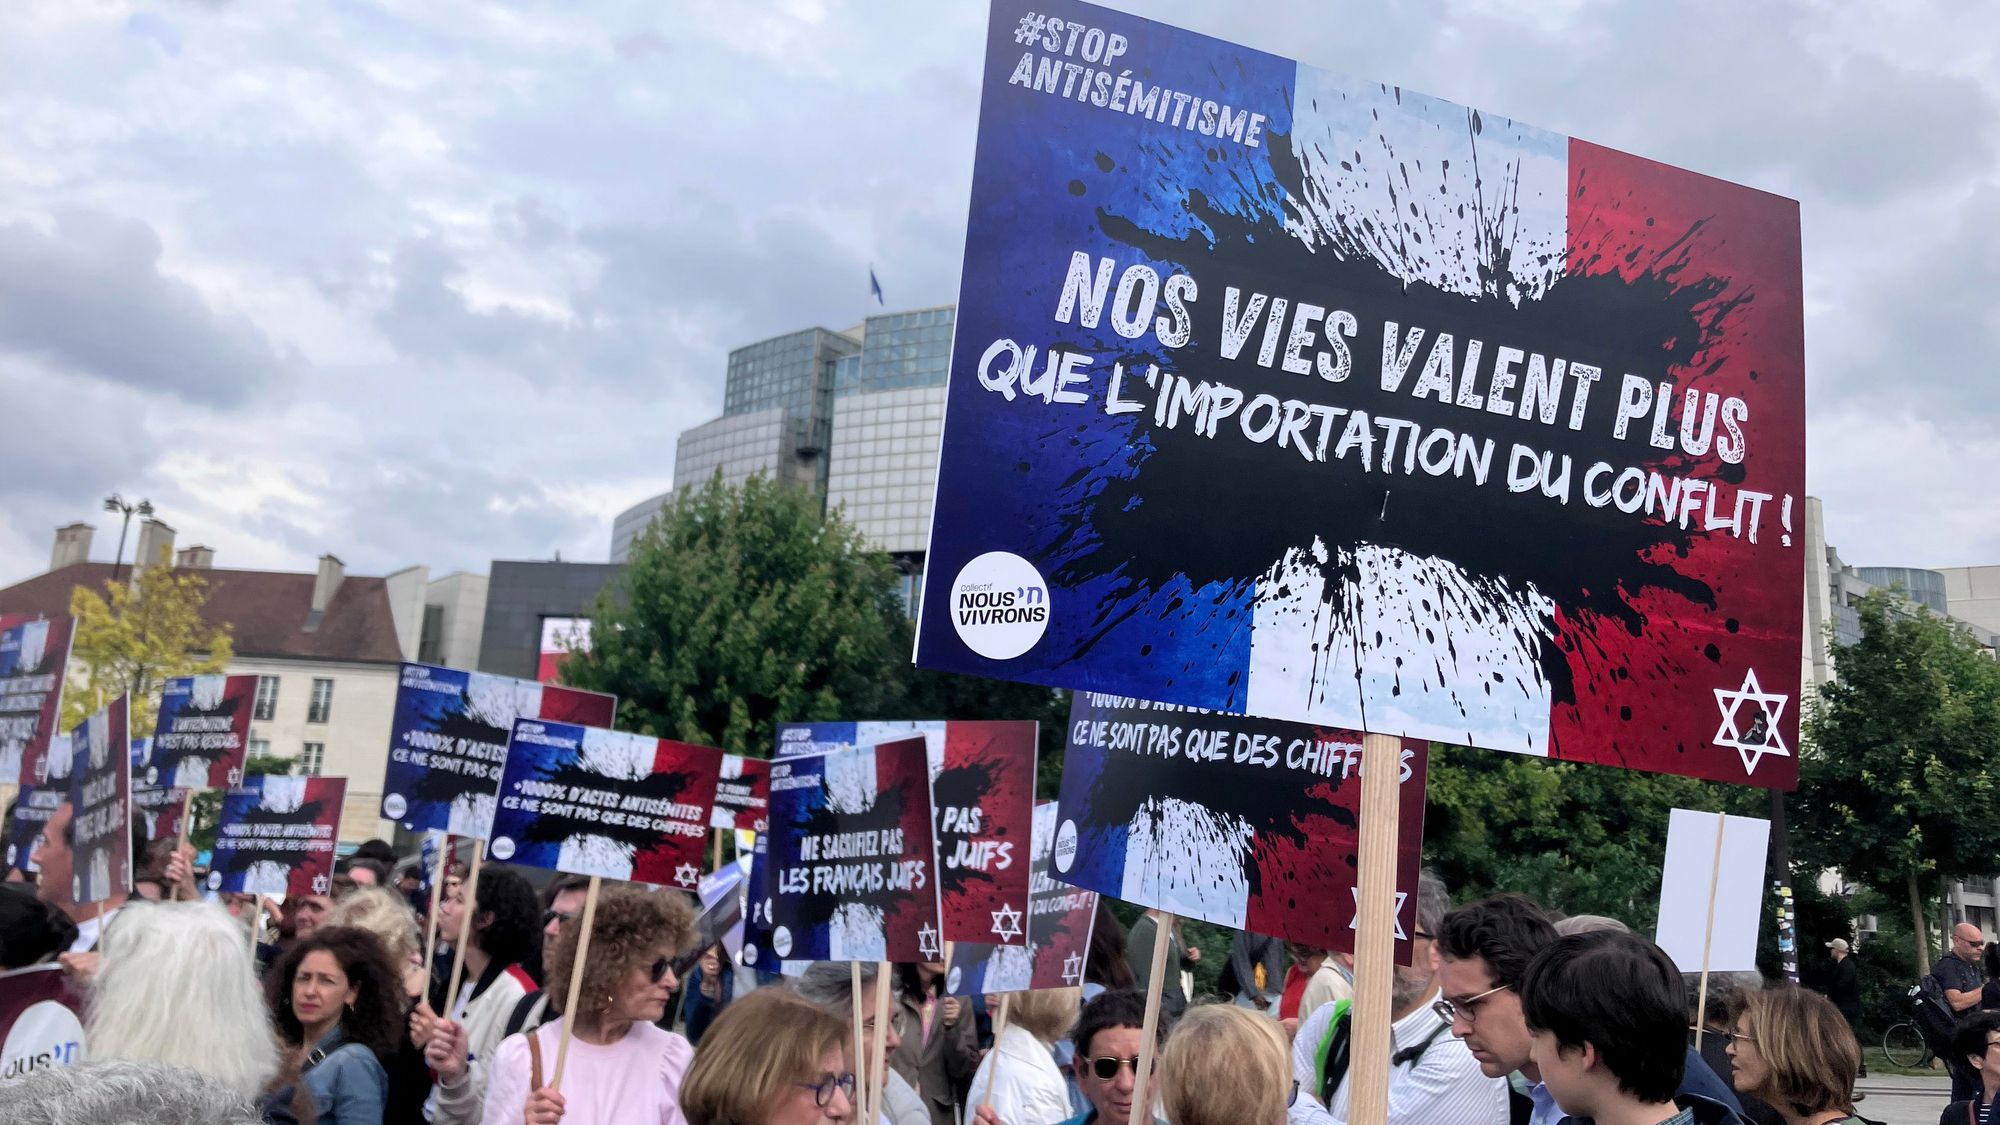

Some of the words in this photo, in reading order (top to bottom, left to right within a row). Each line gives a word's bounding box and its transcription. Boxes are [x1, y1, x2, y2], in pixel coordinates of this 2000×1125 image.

[1014, 12, 1128, 66] #STOP
[1009, 52, 1265, 147] ANTISÉMITISME
[1054, 250, 1197, 348] NOS
[1220, 286, 1357, 382] VIES
[1380, 321, 1601, 430] VALENT
[1613, 374, 1748, 464] PLUS
[977, 338, 1094, 404] QUE
[1105, 362, 1495, 486] L'IMPORTATION
[1507, 443, 1572, 505] DU
[1584, 462, 1773, 545] CONFLIT
[1781, 493, 1793, 547] !
[959, 592, 1015, 609] NOUS
[960, 583, 993, 592] collectif
[959, 607, 1046, 626] VIVRONS
[392, 748, 409, 763] CE
[409, 751, 428, 766] NE
[429, 755, 463, 774] SONT
[462, 760, 488, 778] PAS
[1073, 720, 1088, 746] CE
[1089, 721, 1108, 748] NE
[1108, 722, 1148, 755] SONT
[1147, 723, 1183, 759] PAS
[1185, 728, 1230, 763] QUE
[1233, 733, 1281, 769] DES
[1286, 739, 1415, 784] CHIFFS
[502, 796, 521, 809] CE
[520, 798, 541, 812] NE
[540, 801, 576, 818] SONT
[574, 805, 600, 822] PAS
[600, 810, 627, 826] QUE
[626, 813, 651, 830] DES
[941, 806, 983, 834] PAS
[800, 836, 820, 861] NE
[822, 831, 879, 860] SACRIFIEZ
[881, 828, 904, 855] PAS
[946, 840, 1014, 871] JUIFS
[779, 866, 811, 895] LES
[812, 862, 884, 897] FRANÇAIS
[886, 860, 926, 891] JUIFS
[5, 1053, 51, 1079] OUS
